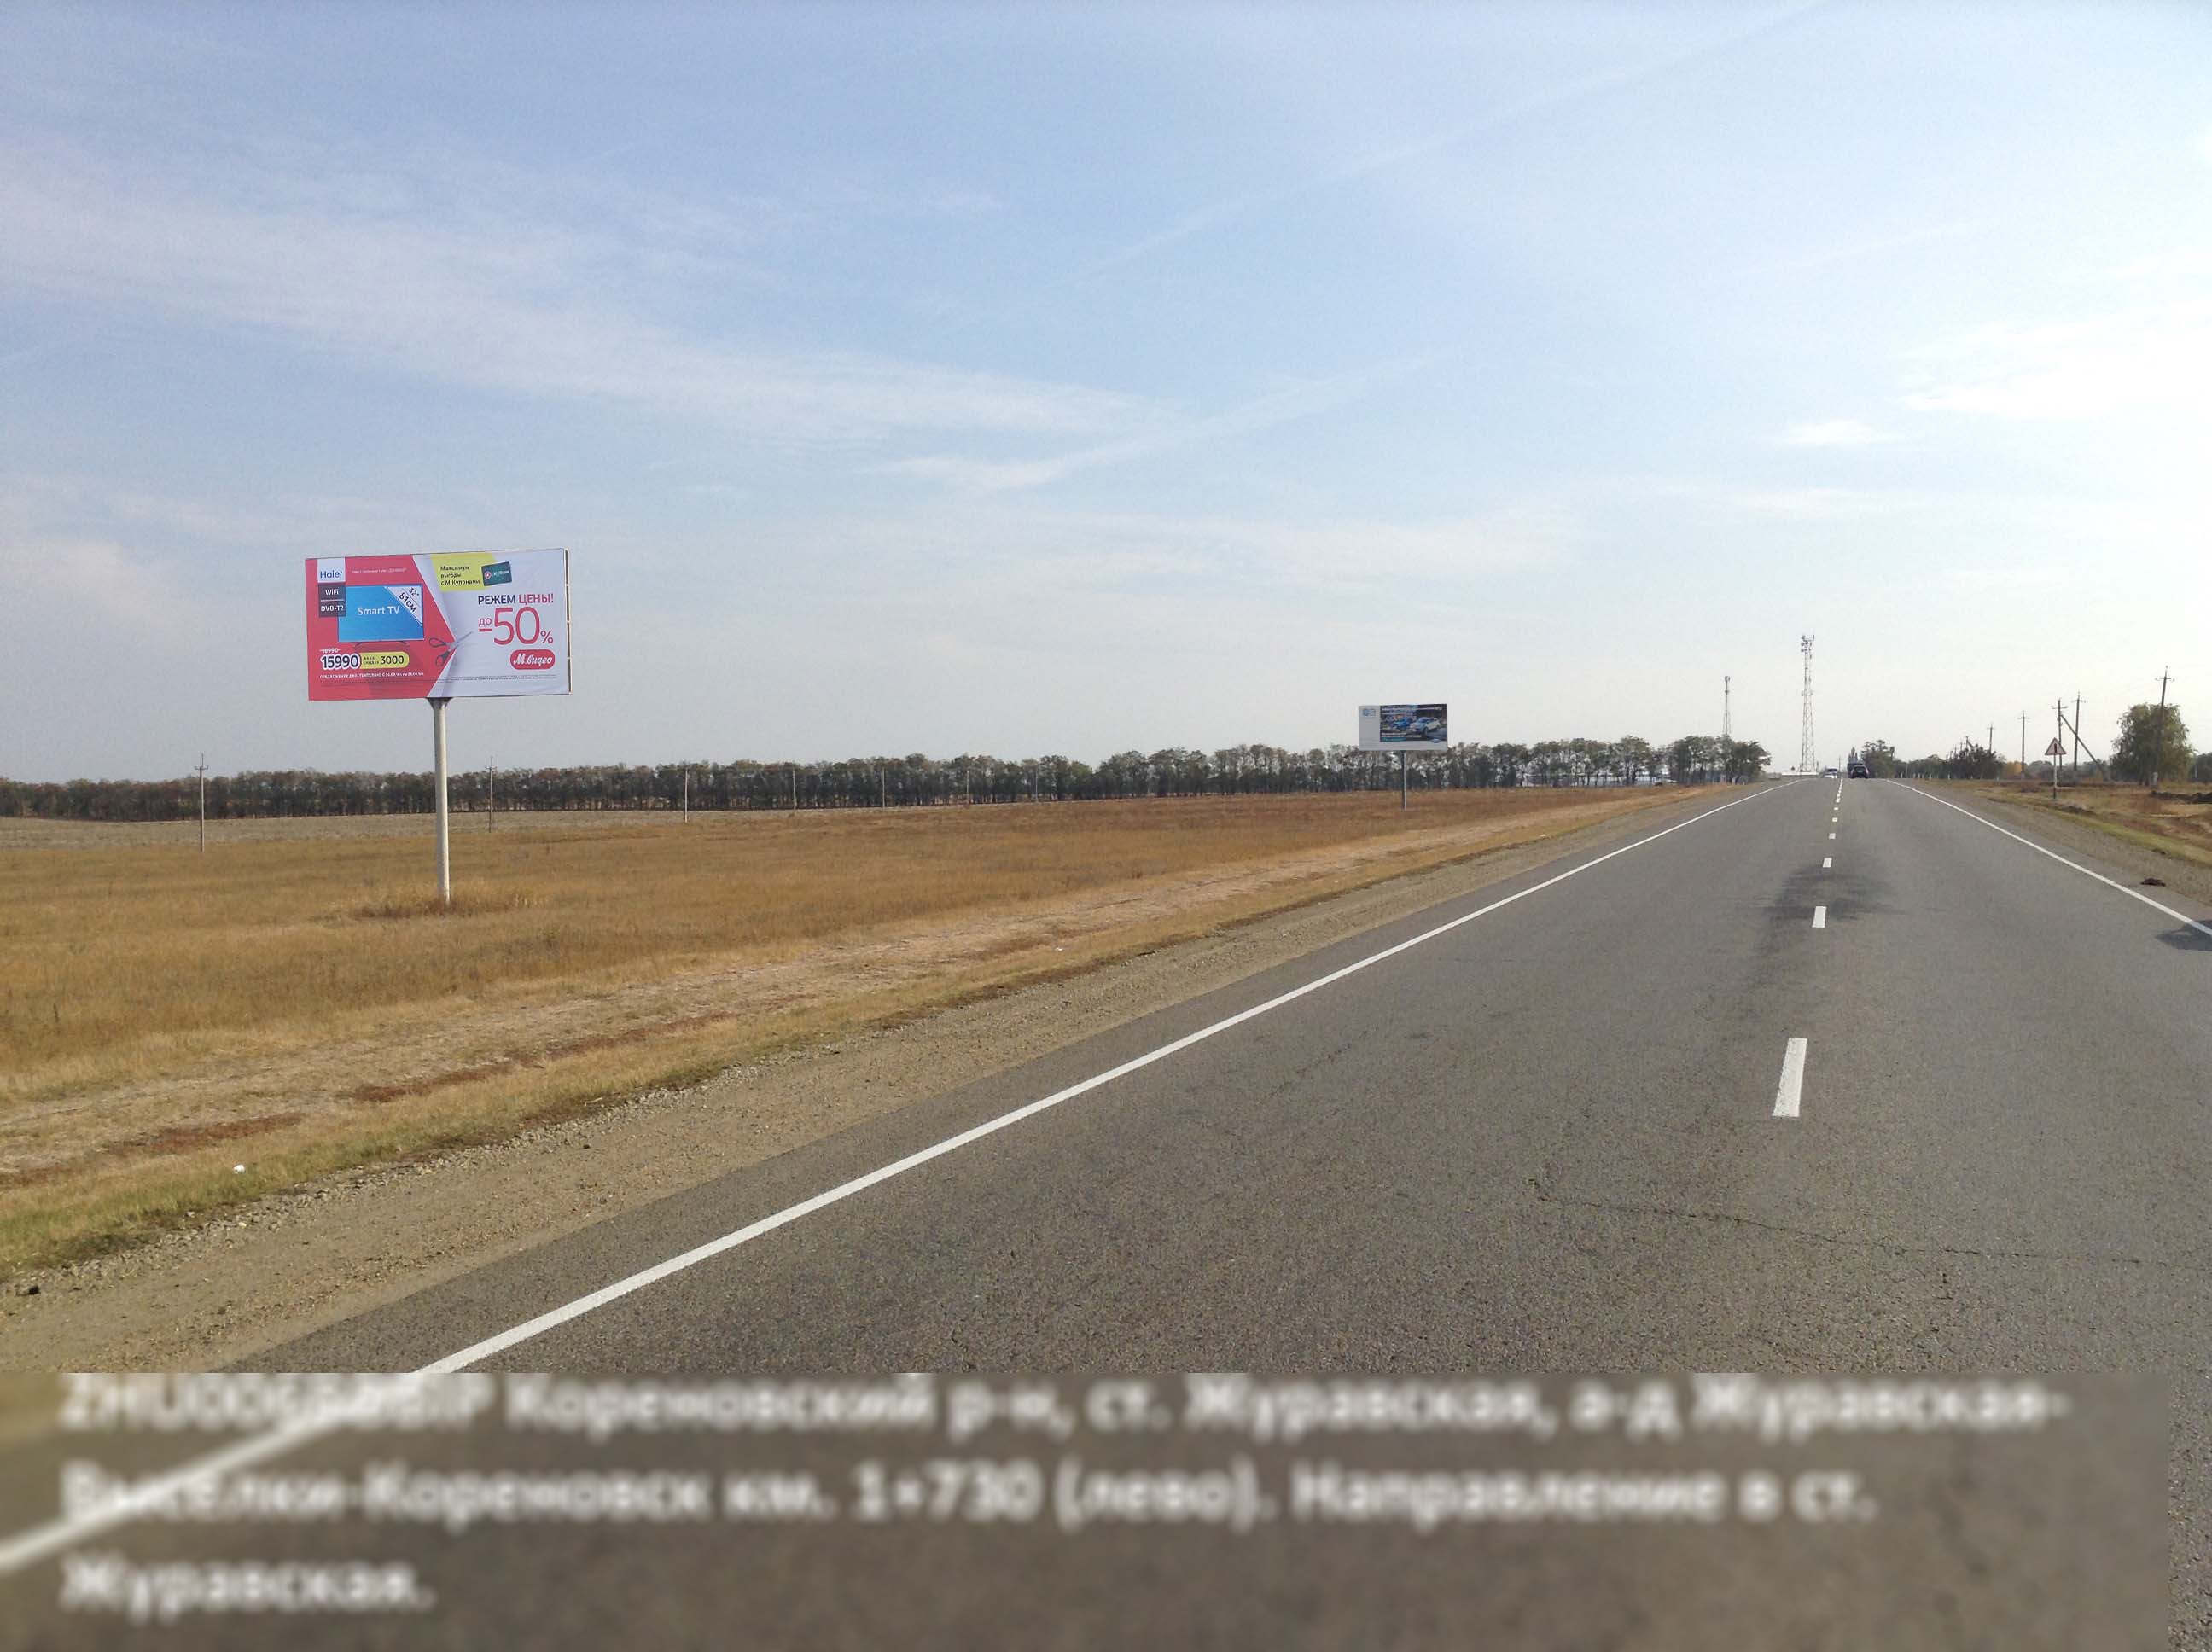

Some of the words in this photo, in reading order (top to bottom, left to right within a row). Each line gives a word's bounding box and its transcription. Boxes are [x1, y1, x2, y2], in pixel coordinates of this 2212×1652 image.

[320, 570, 343, 579] Haier
[478, 595, 516, 605] РЕЖЕМ
[519, 594, 554, 605] ЦЕНЫ!
[358, 607, 386, 615] Smart
[387, 606, 400, 614] TV
[321, 654, 359, 669] 15990
[381, 655, 405, 665] 3000
